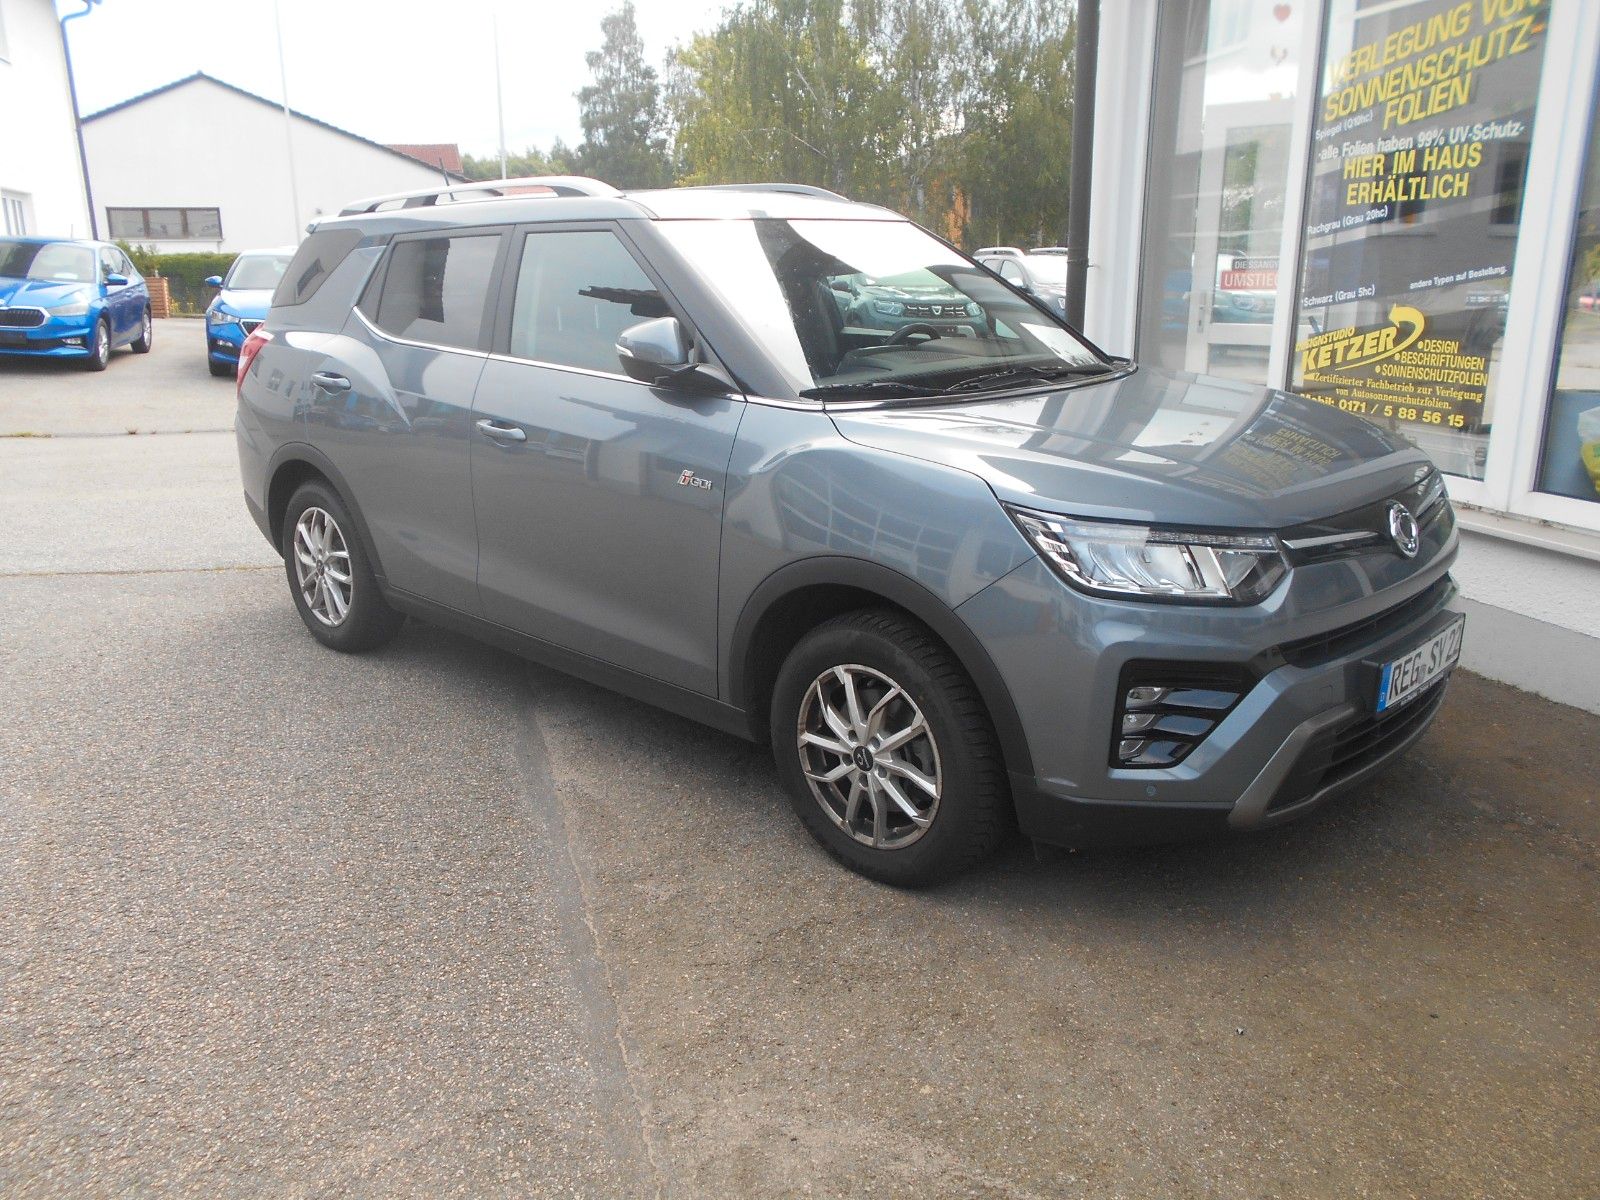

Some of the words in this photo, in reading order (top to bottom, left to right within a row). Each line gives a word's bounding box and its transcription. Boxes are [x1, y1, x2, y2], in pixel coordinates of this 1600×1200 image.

[1328, 2, 1473, 85] VERLEGUNG
[1324, 15, 1544, 122] SONNENSCHUTZ-
[1383, 71, 1472, 130] FOLIEN
[1342, 140, 1375, 157] Folien
[1377, 136, 1413, 153] haben
[1417, 128, 1445, 148] 99%
[1343, 153, 1385, 179] HIER
[1392, 149, 1415, 175] IM
[1423, 141, 1483, 171] HAUS
[1346, 172, 1471, 205] ERHÄLTLICH
[1301, 326, 1397, 372] KETZER
[1400, 351, 1485, 370] BESCHRIFTUNGEN
[1423, 339, 1459, 354] DESIGN
[1366, 378, 1415, 393] Fachbetrieb
[1417, 386, 1433, 395] zur
[1435, 386, 1484, 403] Verlegung
[1381, 363, 1488, 387] SONNENSCHUTZFOLIEN
[1336, 388, 1349, 397] von
[1300, 393, 1335, 406] bil:
[1339, 399, 1367, 413] 0171
[1384, 405, 1393, 417] 5
[1398, 407, 1417, 421] 88
[1422, 410, 1442, 425] 56
[1447, 414, 1464, 428] 15
[1389, 651, 1422, 700] REG
